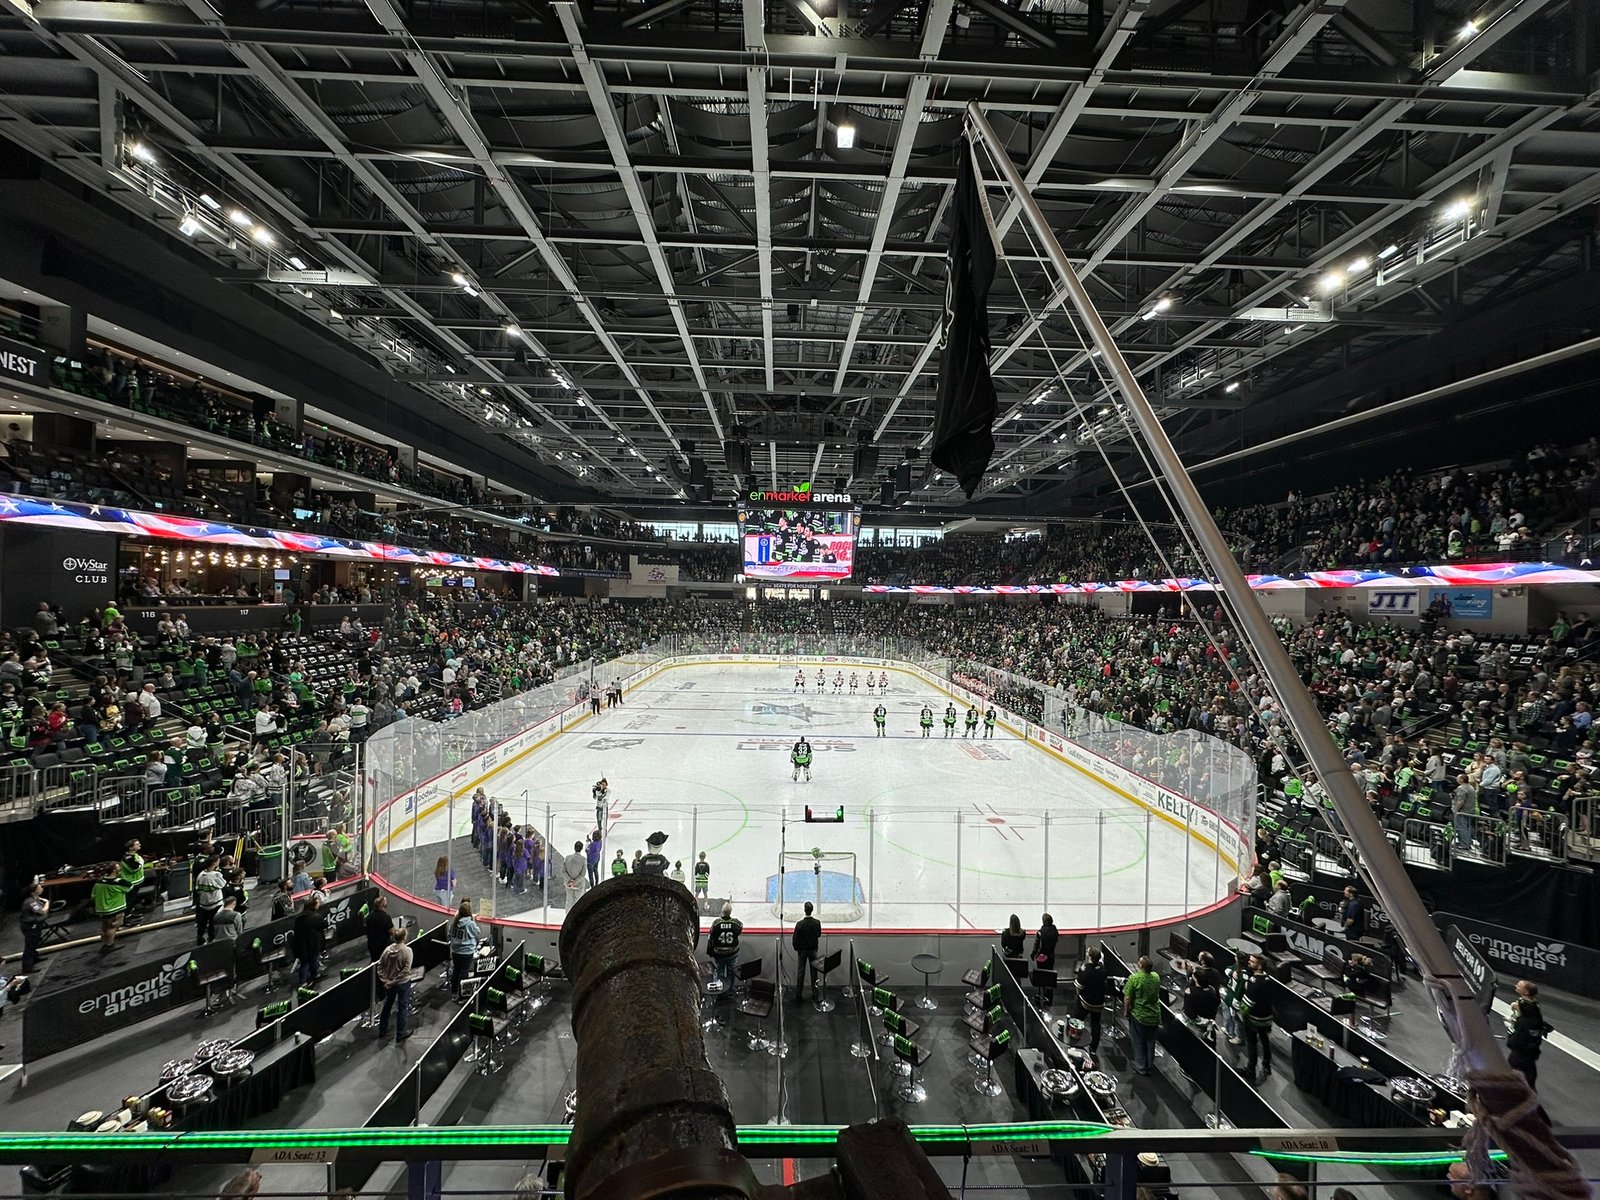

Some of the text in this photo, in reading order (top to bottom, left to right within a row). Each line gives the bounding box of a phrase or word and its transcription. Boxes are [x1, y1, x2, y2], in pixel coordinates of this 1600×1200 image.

[0, 351, 37, 376] NEST
[750, 490, 851, 503] enmarket arena
[76, 558, 107, 571] VyStar
[75, 575, 107, 583] CLUB
[1157, 790, 1195, 823] KELLY
[718, 931, 734, 944] 46
[1468, 933, 1568, 967] enmarket
[1487, 947, 1547, 971] arena
[78, 968, 186, 1014] enmarke
[104, 984, 172, 1017] arena
[991, 1143, 1009, 1153] ADA
[1031, 1143, 1039, 1153] 11
[1280, 1140, 1329, 1150] ADA Seat: 10
[271, 1150, 326, 1160] ADA Seat: 13
